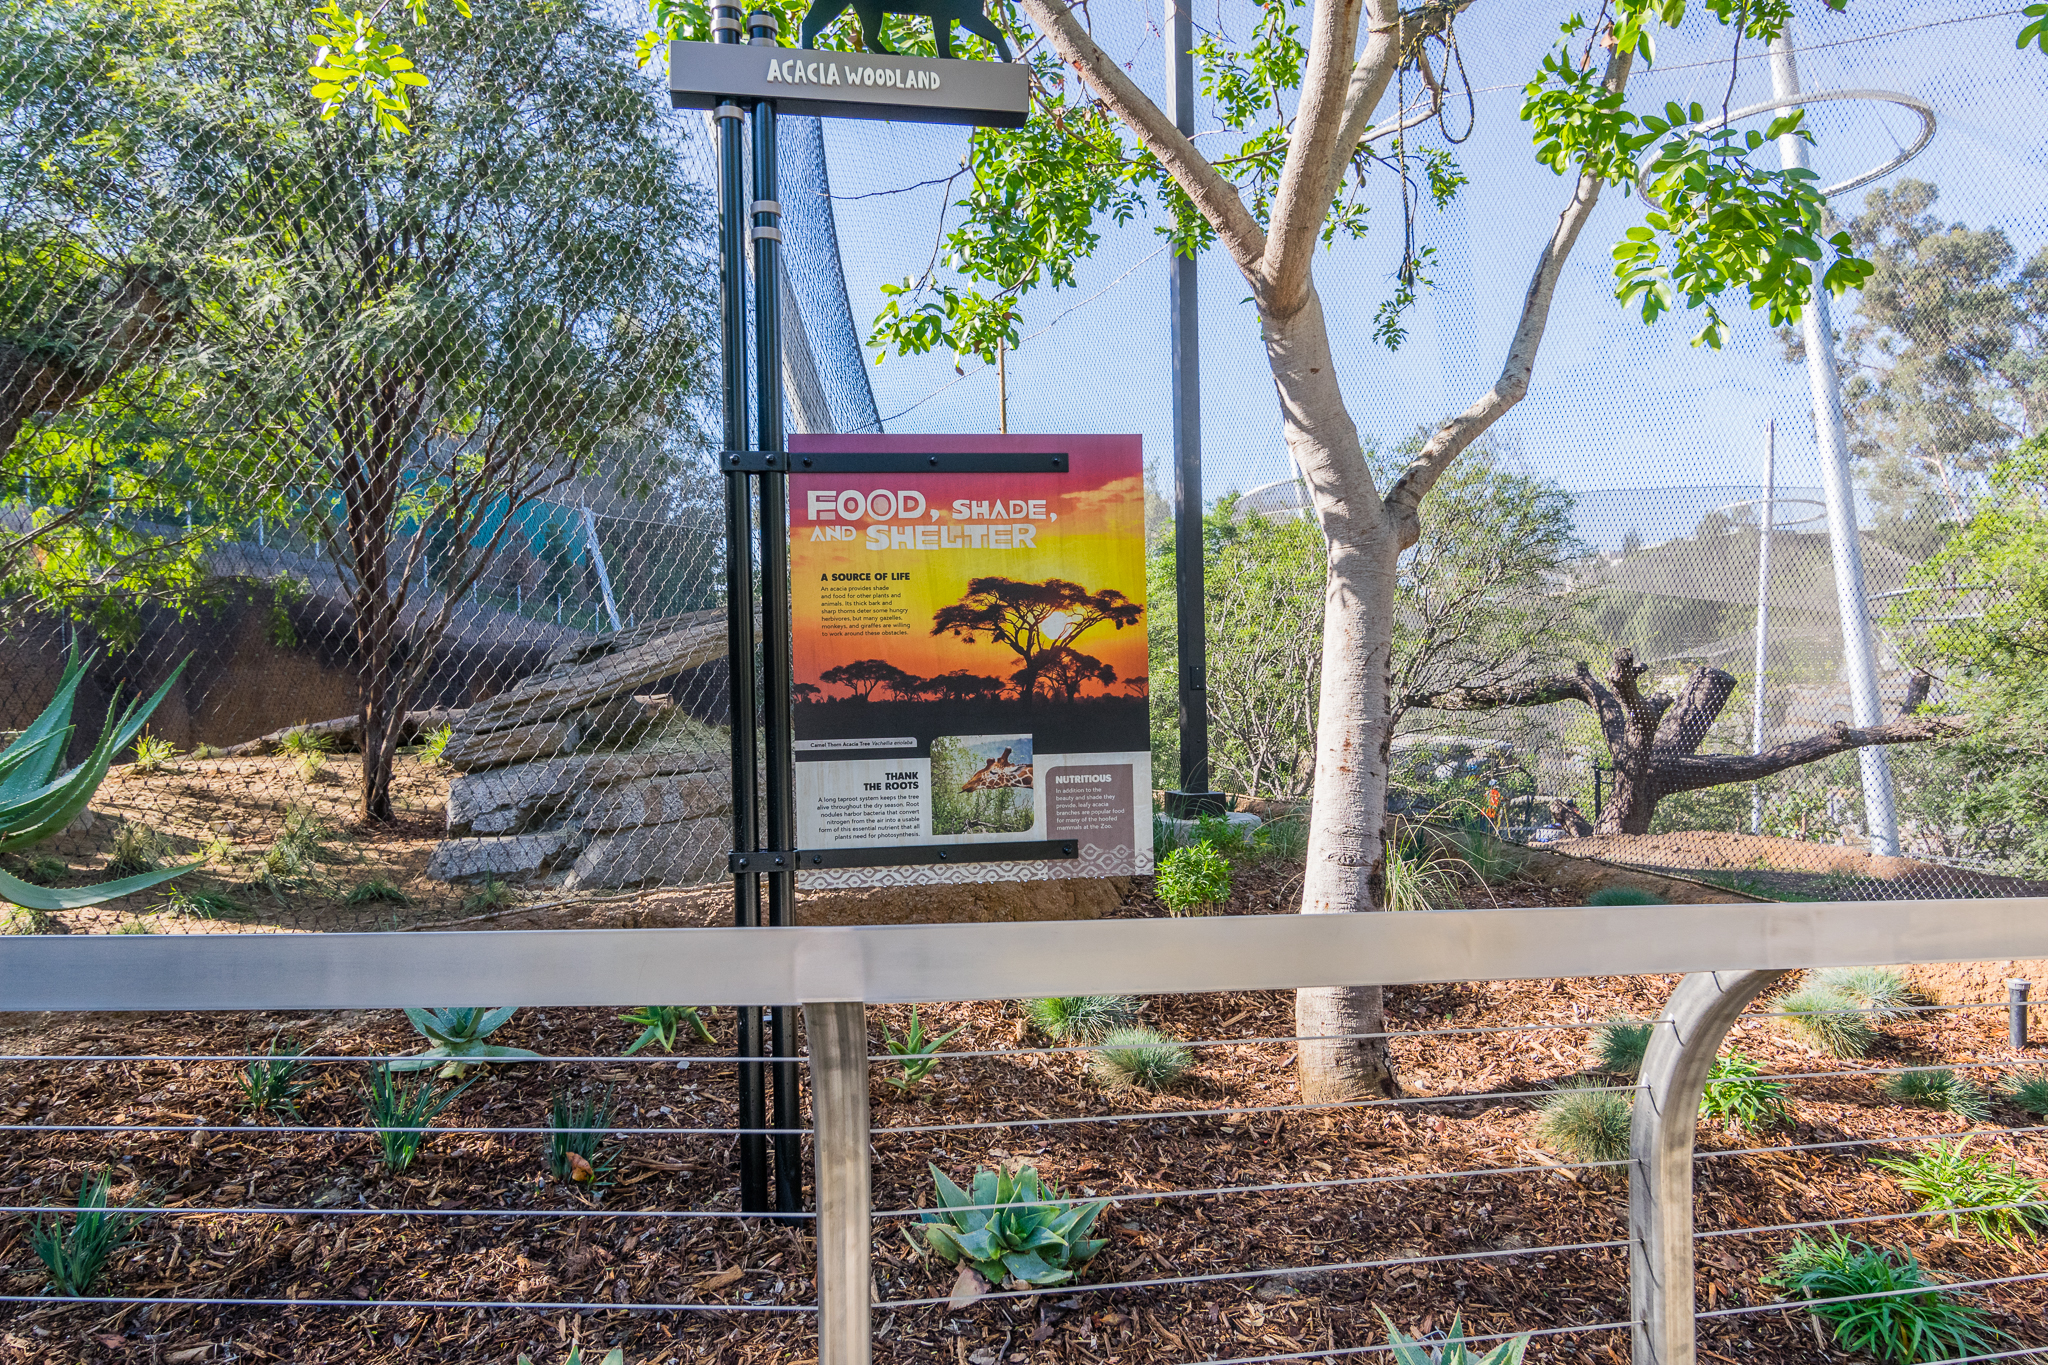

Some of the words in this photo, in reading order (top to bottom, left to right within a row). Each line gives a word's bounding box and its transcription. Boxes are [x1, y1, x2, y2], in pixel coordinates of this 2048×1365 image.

[766, 59, 840, 86] ACACIA
[844, 66, 940, 90] WOODLAND
[807, 489, 940, 523] FOOD,
[952, 499, 1057, 523] SHADE,
[810, 525, 856, 541] AND
[866, 523, 1037, 550] SHELTER
[885, 772, 918, 780] THANK
[1056, 774, 1112, 784] NUTRITIOUS
[885, 782, 919, 790] ROOTS
